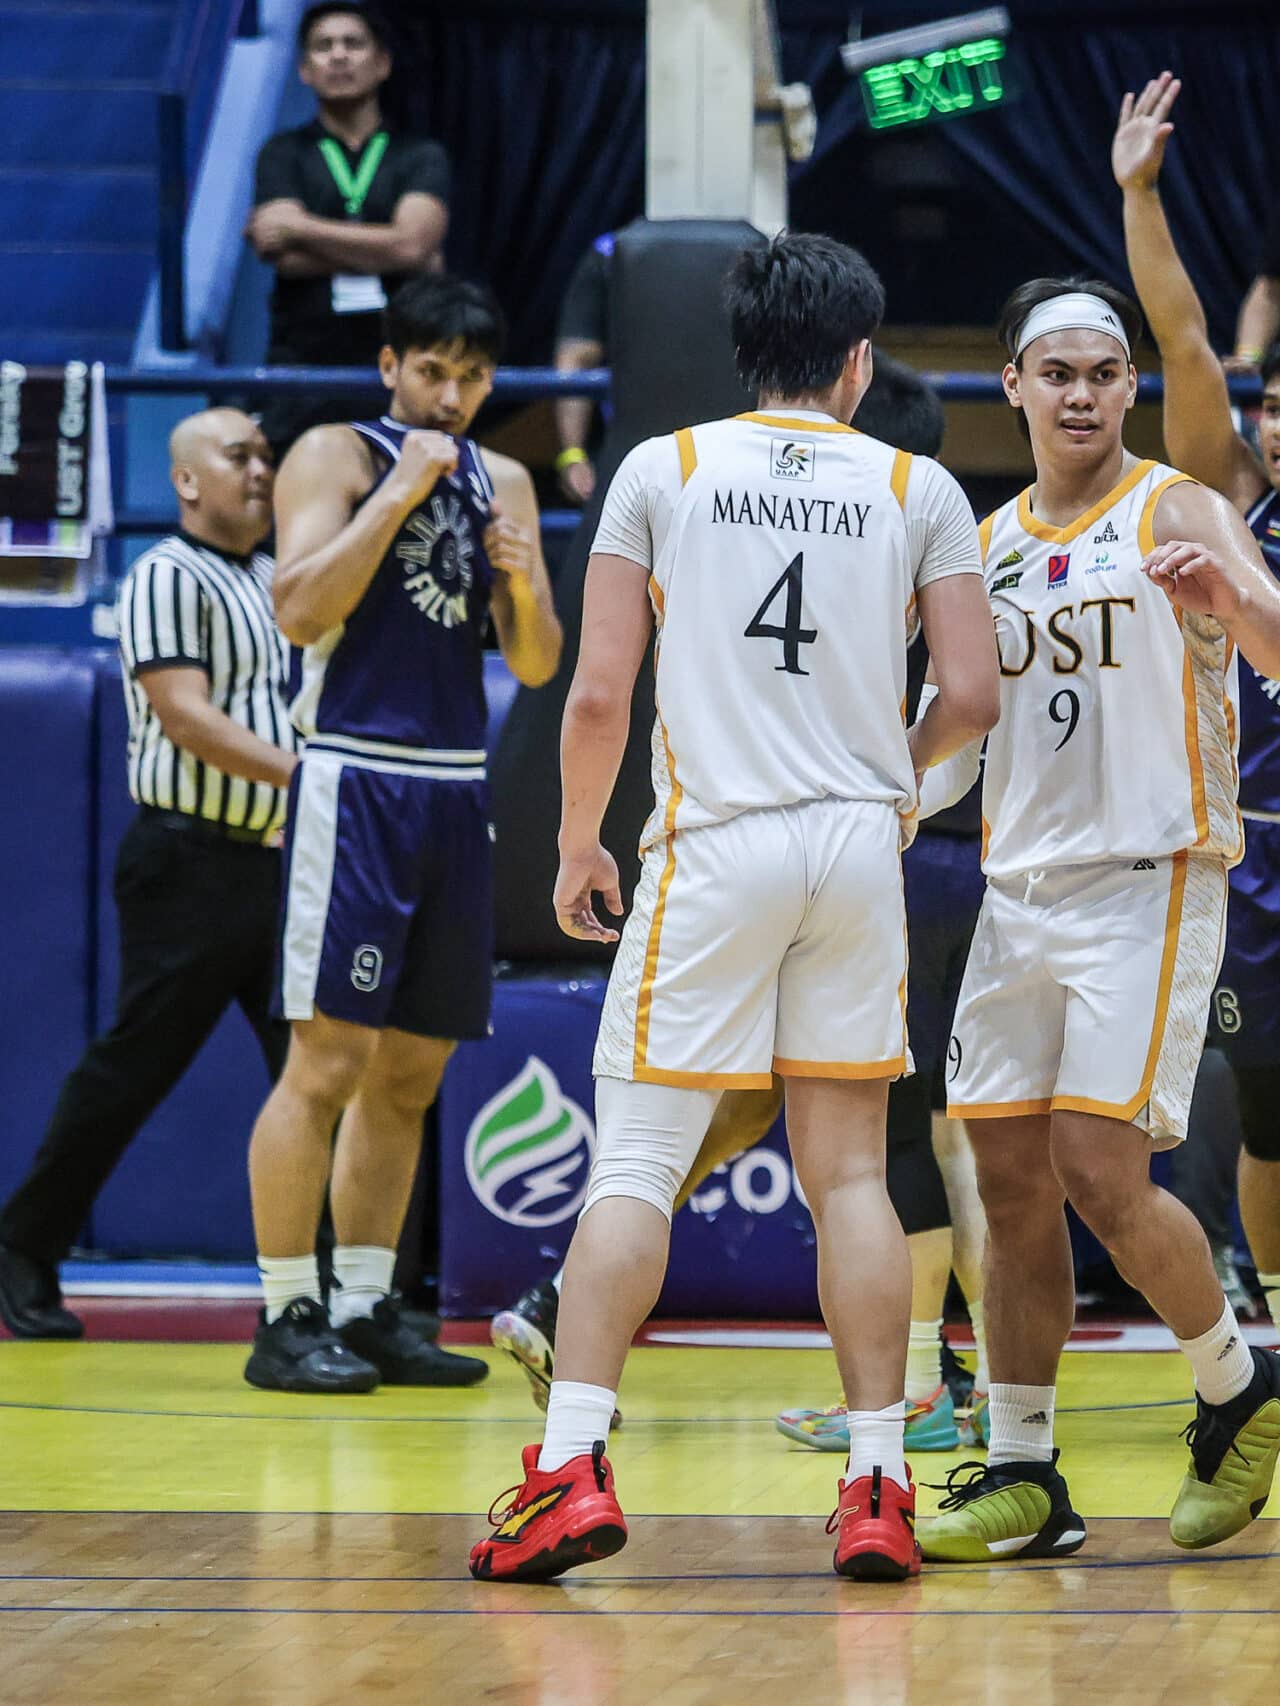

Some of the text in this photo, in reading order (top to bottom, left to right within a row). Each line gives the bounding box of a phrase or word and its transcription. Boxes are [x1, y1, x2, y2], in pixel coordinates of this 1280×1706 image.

[865, 39, 1003, 128] EXIT
[712, 488, 872, 538] MANAYTAY
[1094, 533, 1119, 544] DLTA
[744, 551, 818, 676] 4
[993, 597, 1136, 678] UST
[1048, 688, 1080, 752] 9
[350, 944, 383, 992] 9
[1215, 986, 1242, 1033] 6
[949, 1035, 962, 1083] 9
